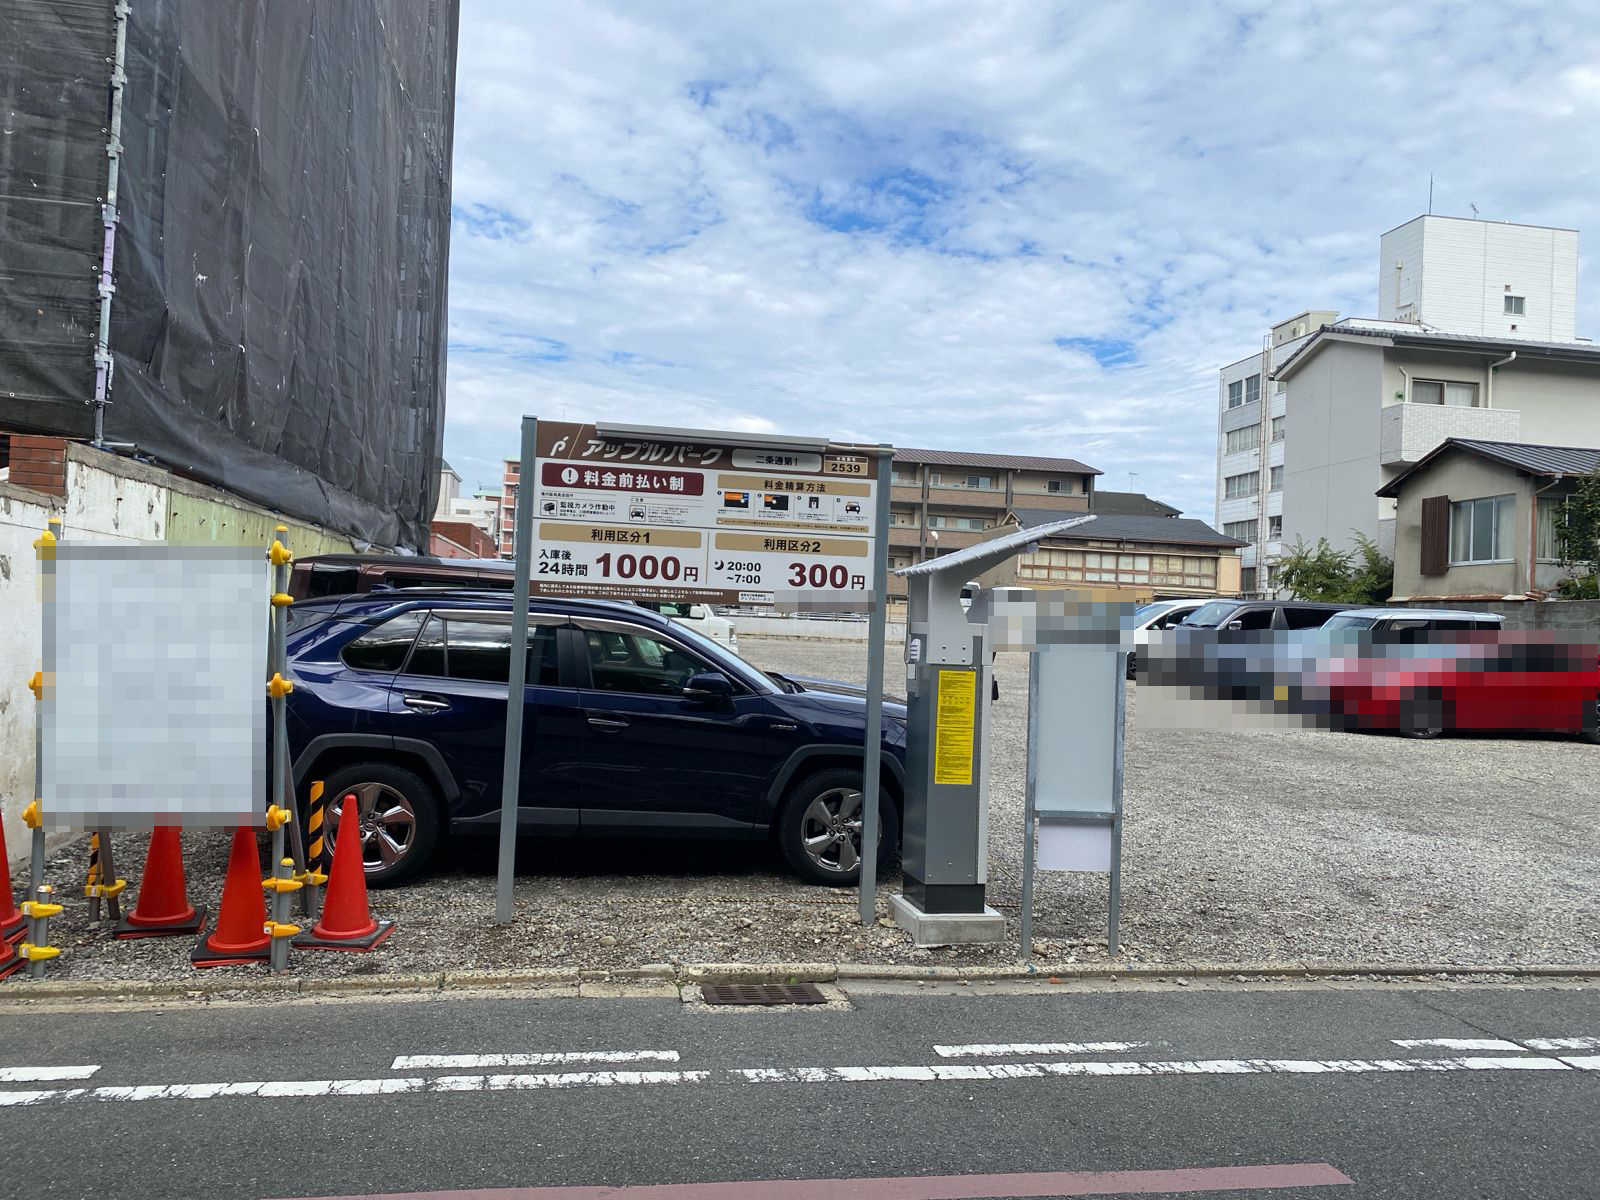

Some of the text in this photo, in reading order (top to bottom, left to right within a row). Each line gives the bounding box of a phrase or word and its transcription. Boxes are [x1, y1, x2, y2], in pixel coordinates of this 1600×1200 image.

[581, 439, 723, 465] アップルパーク
[756, 455, 799, 467] 二条通第1
[831, 463, 861, 473] 2539
[583, 470, 684, 491] 料金前払い制
[763, 479, 826, 493] 料金精算方法
[560, 501, 616, 511] 監視カメラ作動中
[591, 528, 651, 544] 利用区分1
[763, 538, 821, 553] 利用区分2
[538, 549, 572, 561] 入庫後
[538, 561, 588, 577] 24時間
[727, 561, 762, 572] 20:00
